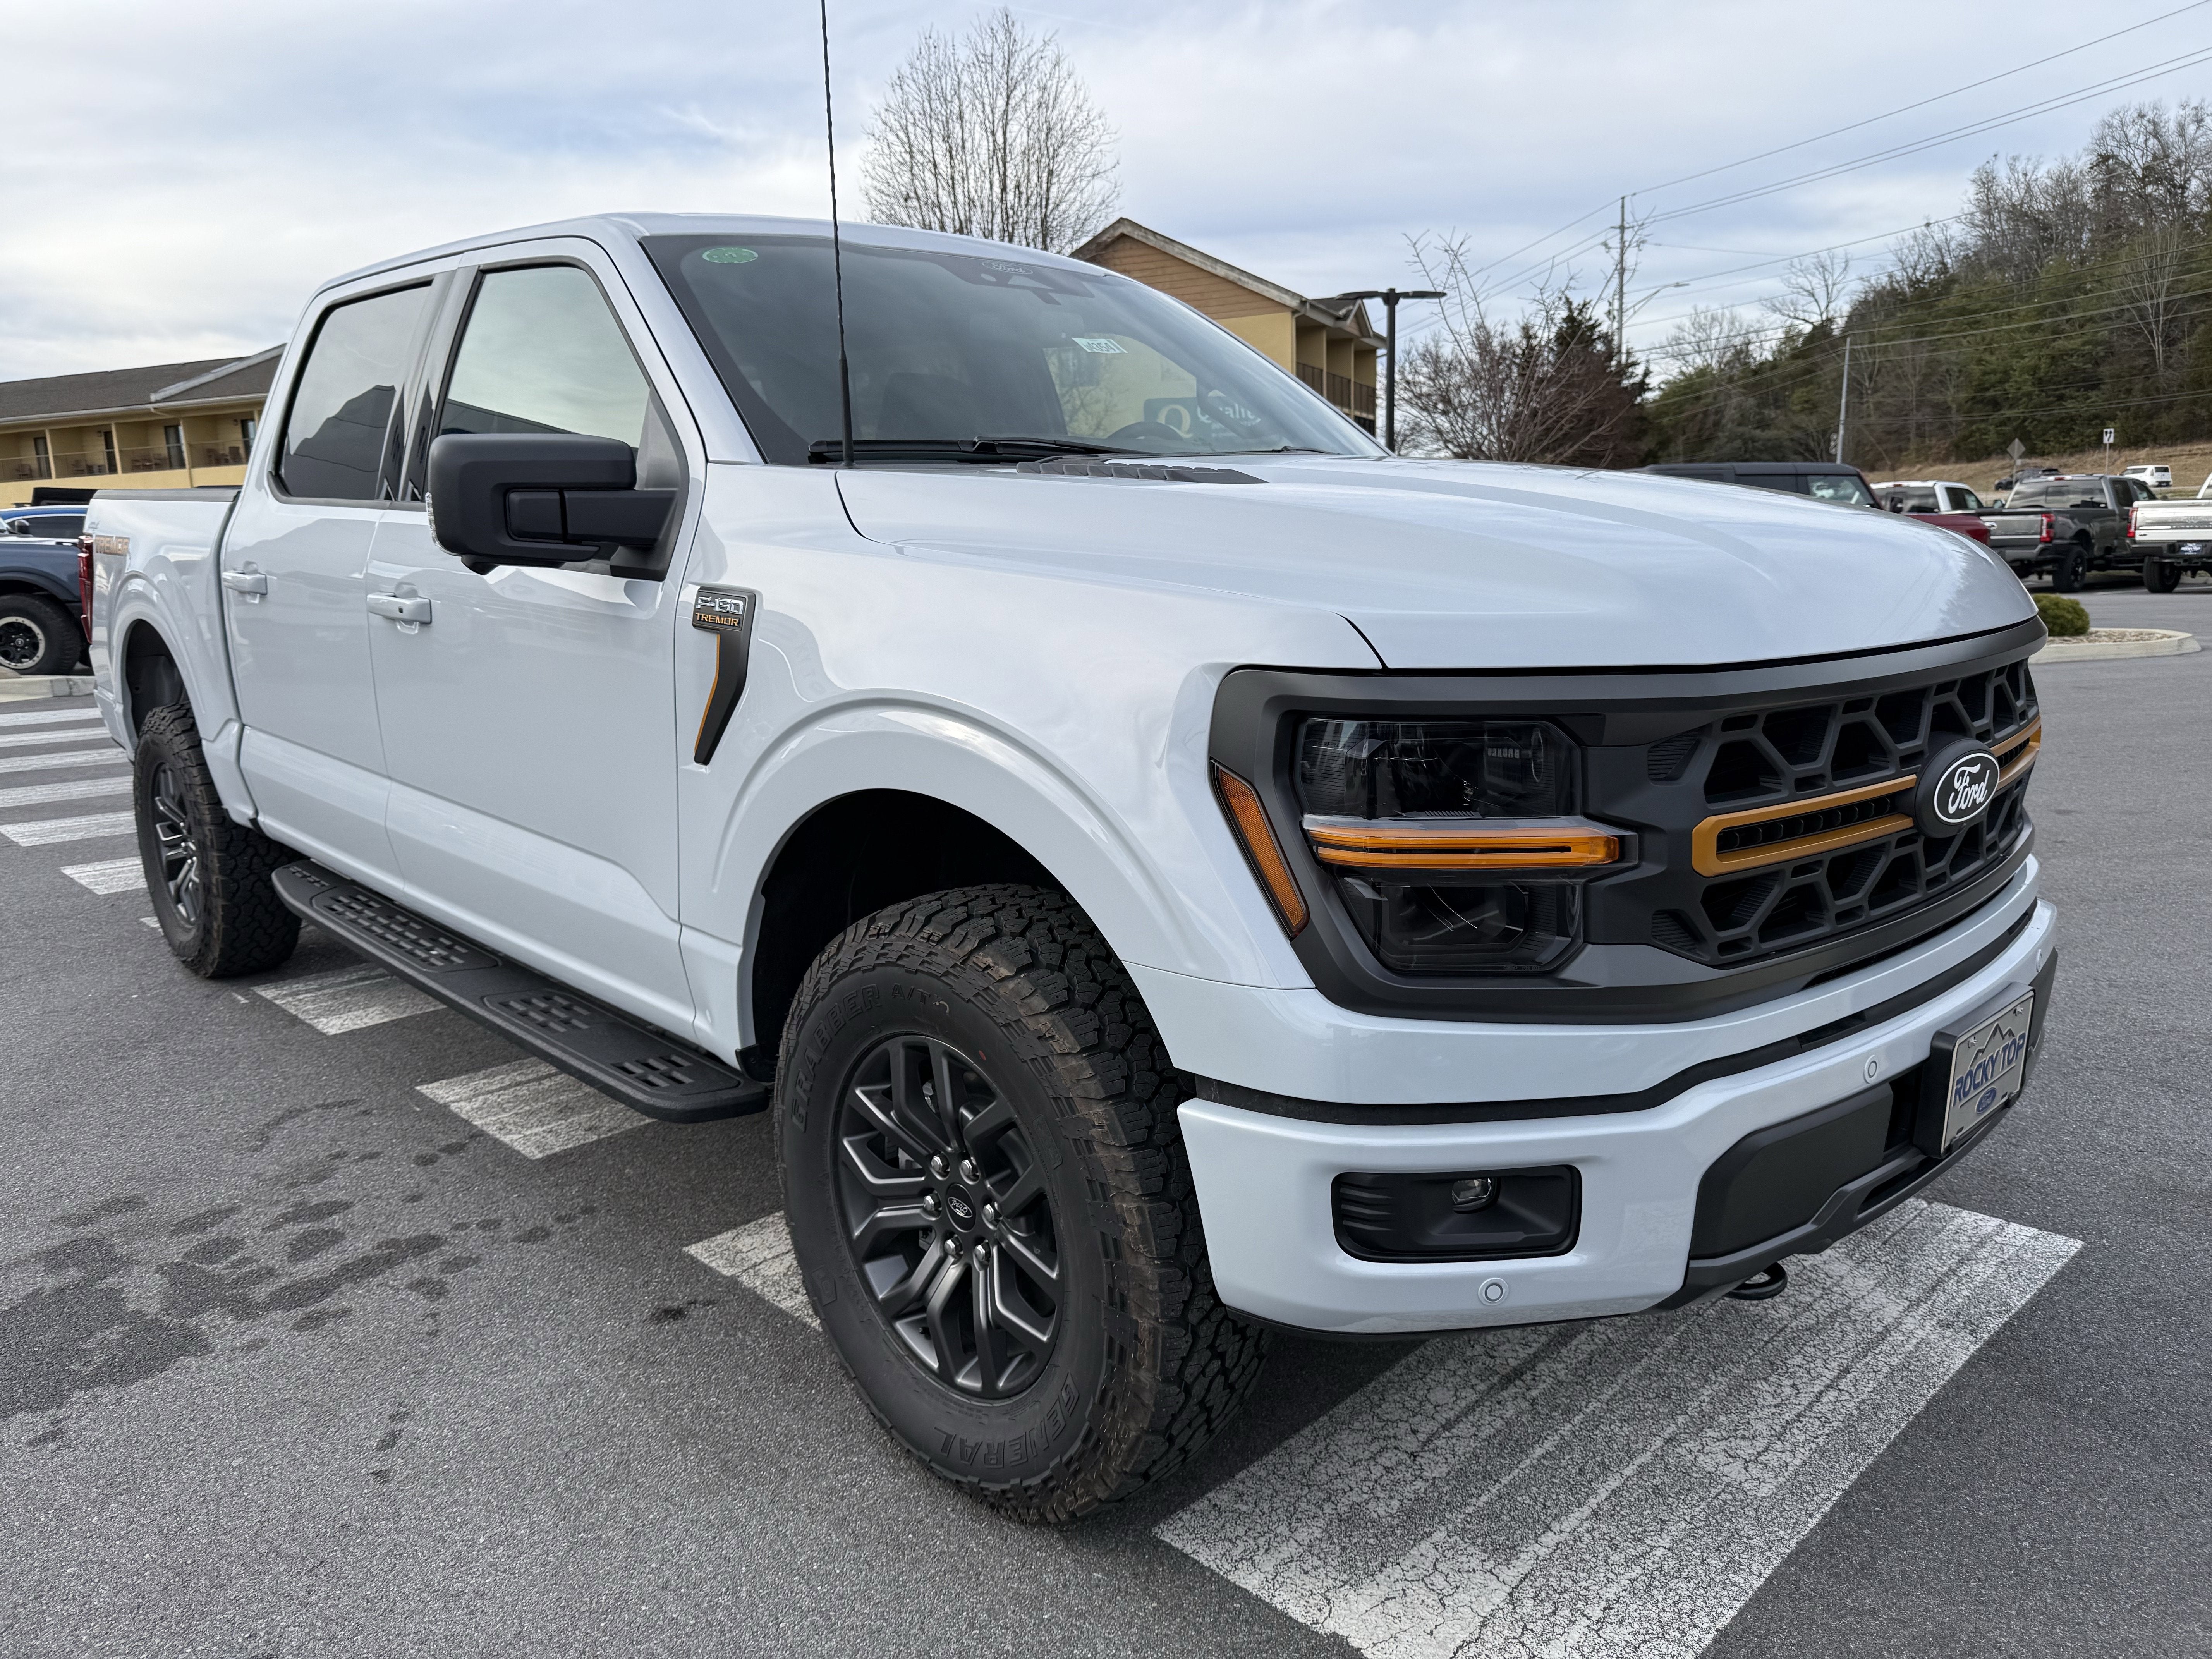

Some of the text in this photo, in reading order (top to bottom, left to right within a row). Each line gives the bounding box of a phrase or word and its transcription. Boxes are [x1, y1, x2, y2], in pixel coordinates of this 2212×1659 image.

[991, 262, 1026, 273] Ford
[695, 613, 740, 627] TREMOR
[696, 596, 743, 615] F-150
[1948, 763, 1990, 814] Ford
[792, 984, 882, 1133] GRABBER
[1951, 1031, 2026, 1107] ROCKY TOP
[951, 1199, 968, 1216] Ford
[934, 1371, 1080, 1469] GENERAL
